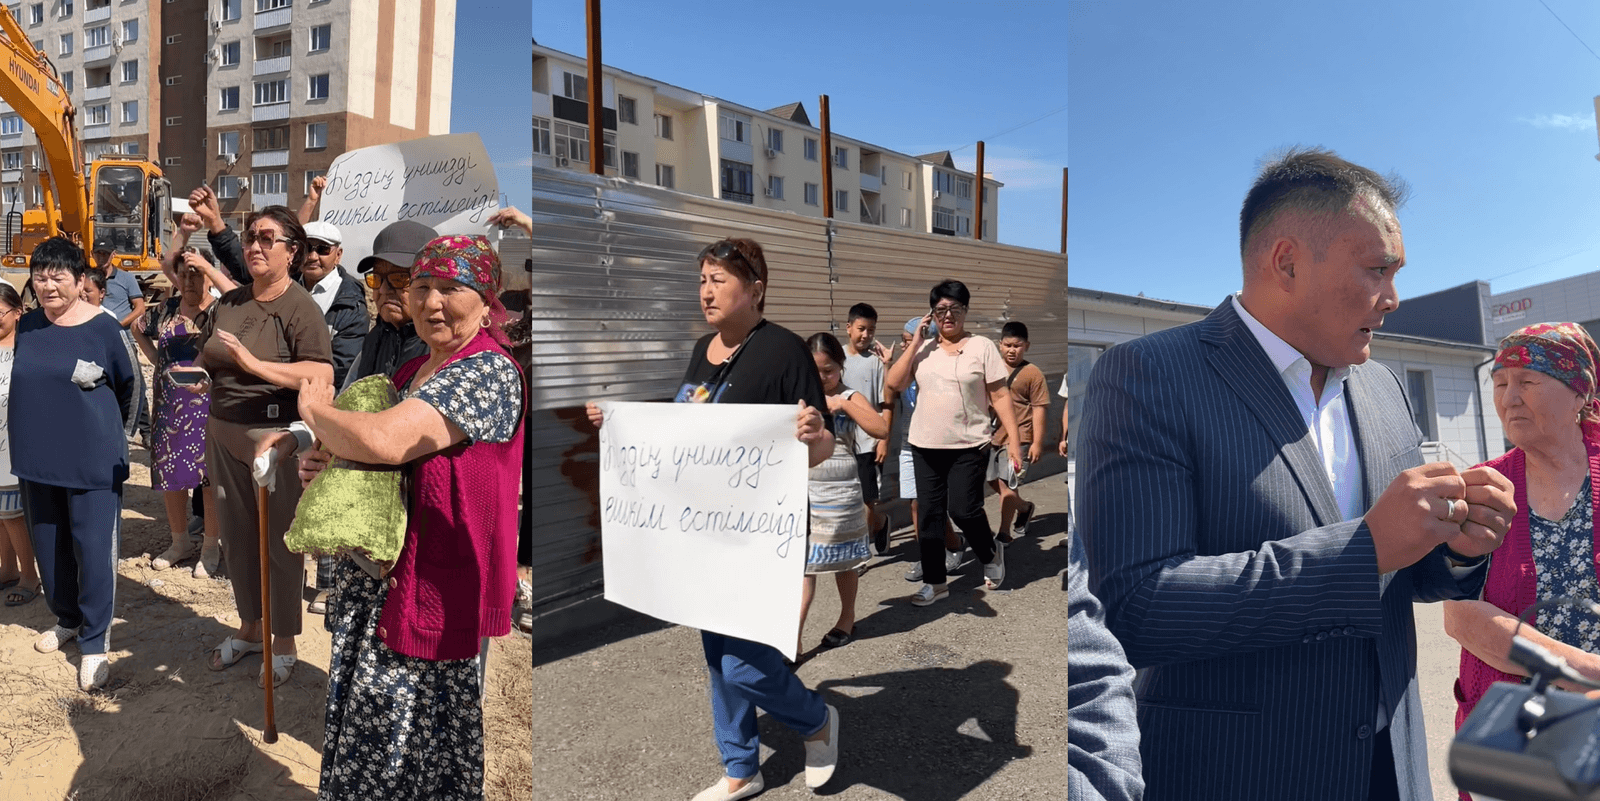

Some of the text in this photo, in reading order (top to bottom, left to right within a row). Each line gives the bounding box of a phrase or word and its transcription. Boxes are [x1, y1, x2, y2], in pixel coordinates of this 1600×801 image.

[9, 56, 39, 96] HYUNDAI
[324, 184, 498, 226] ешкім естімейді
[679, 494, 804, 559] естімейді
